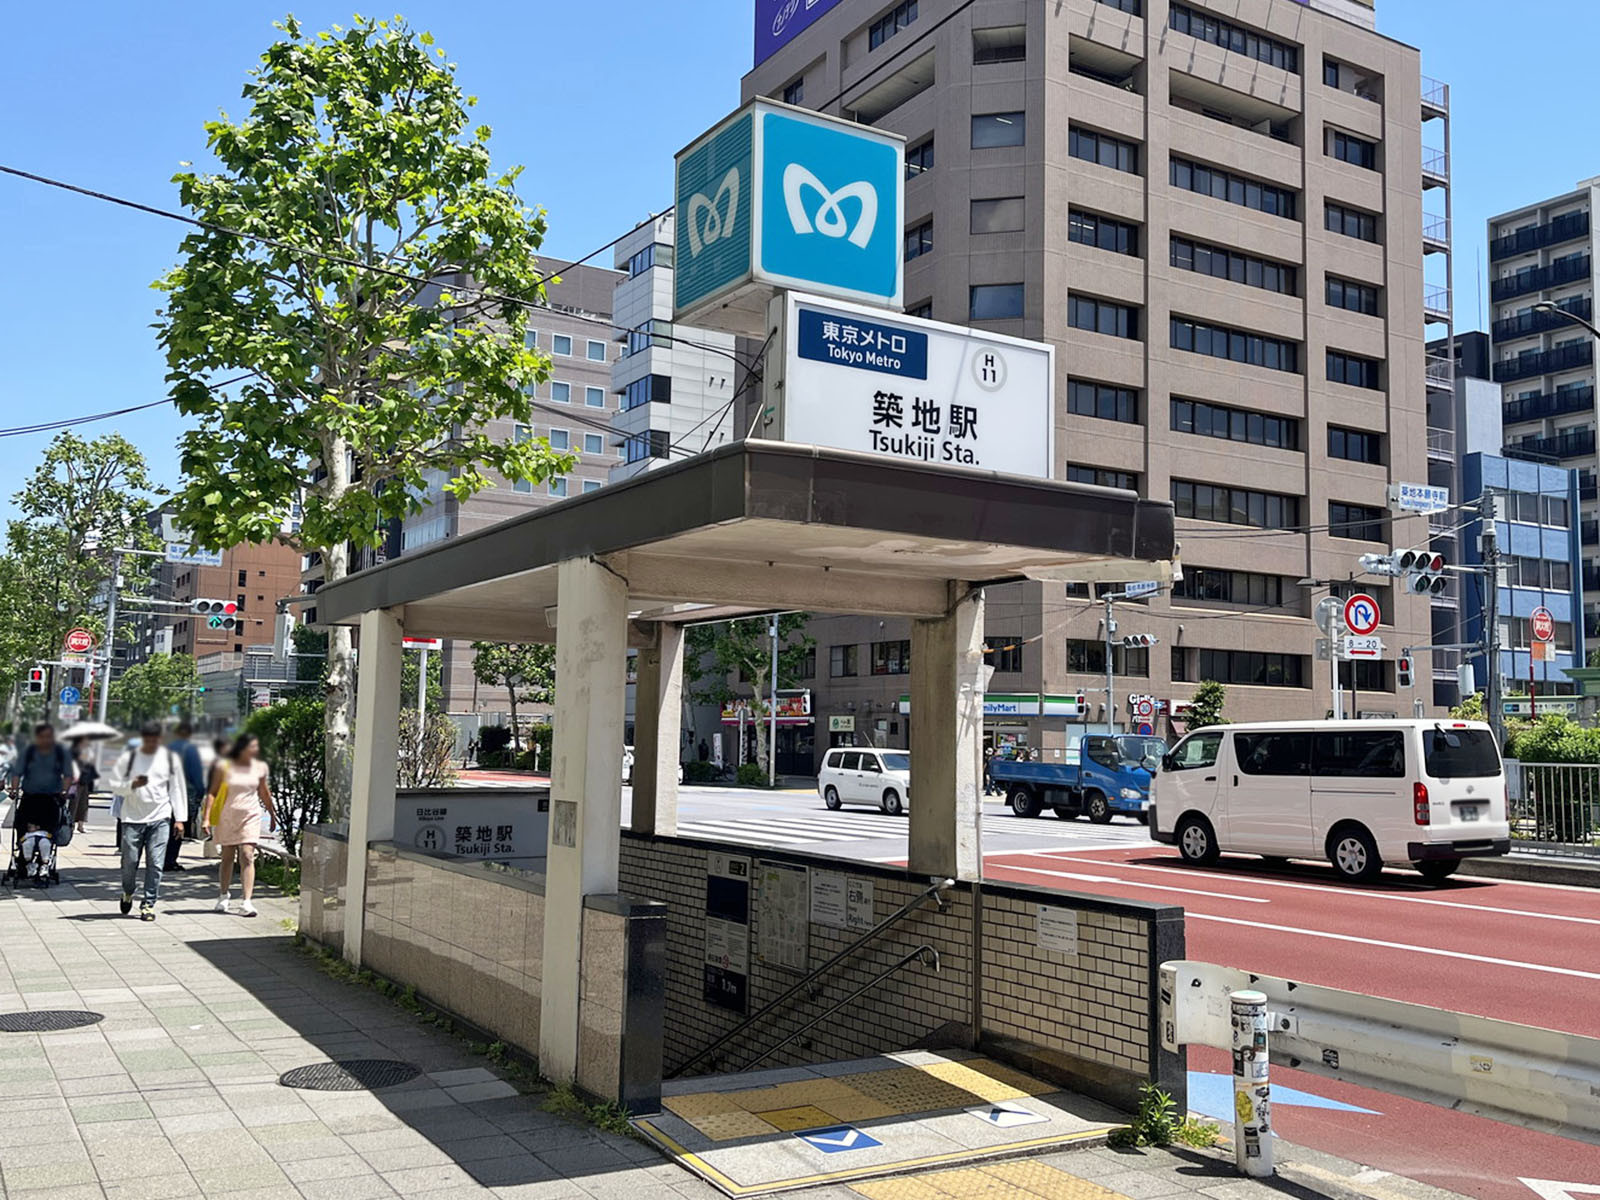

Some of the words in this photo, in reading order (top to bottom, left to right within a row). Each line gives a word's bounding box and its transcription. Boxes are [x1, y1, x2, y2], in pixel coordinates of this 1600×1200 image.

[822, 321, 906, 354] 東京メトロ
[827, 343, 863, 364] Tokyo
[866, 351, 901, 369] Metro
[985, 354, 994, 367] H
[982, 368, 996, 383] 11
[873, 390, 978, 441] 築地駅
[869, 429, 935, 461] Tsukiji
[943, 440, 980, 465] Sta.
[426, 830, 435, 839] H
[455, 825, 513, 843] 築地駅
[424, 840, 436, 850] 11
[454, 843, 490, 856] Tsukiji
[494, 843, 515, 854] Sta.
